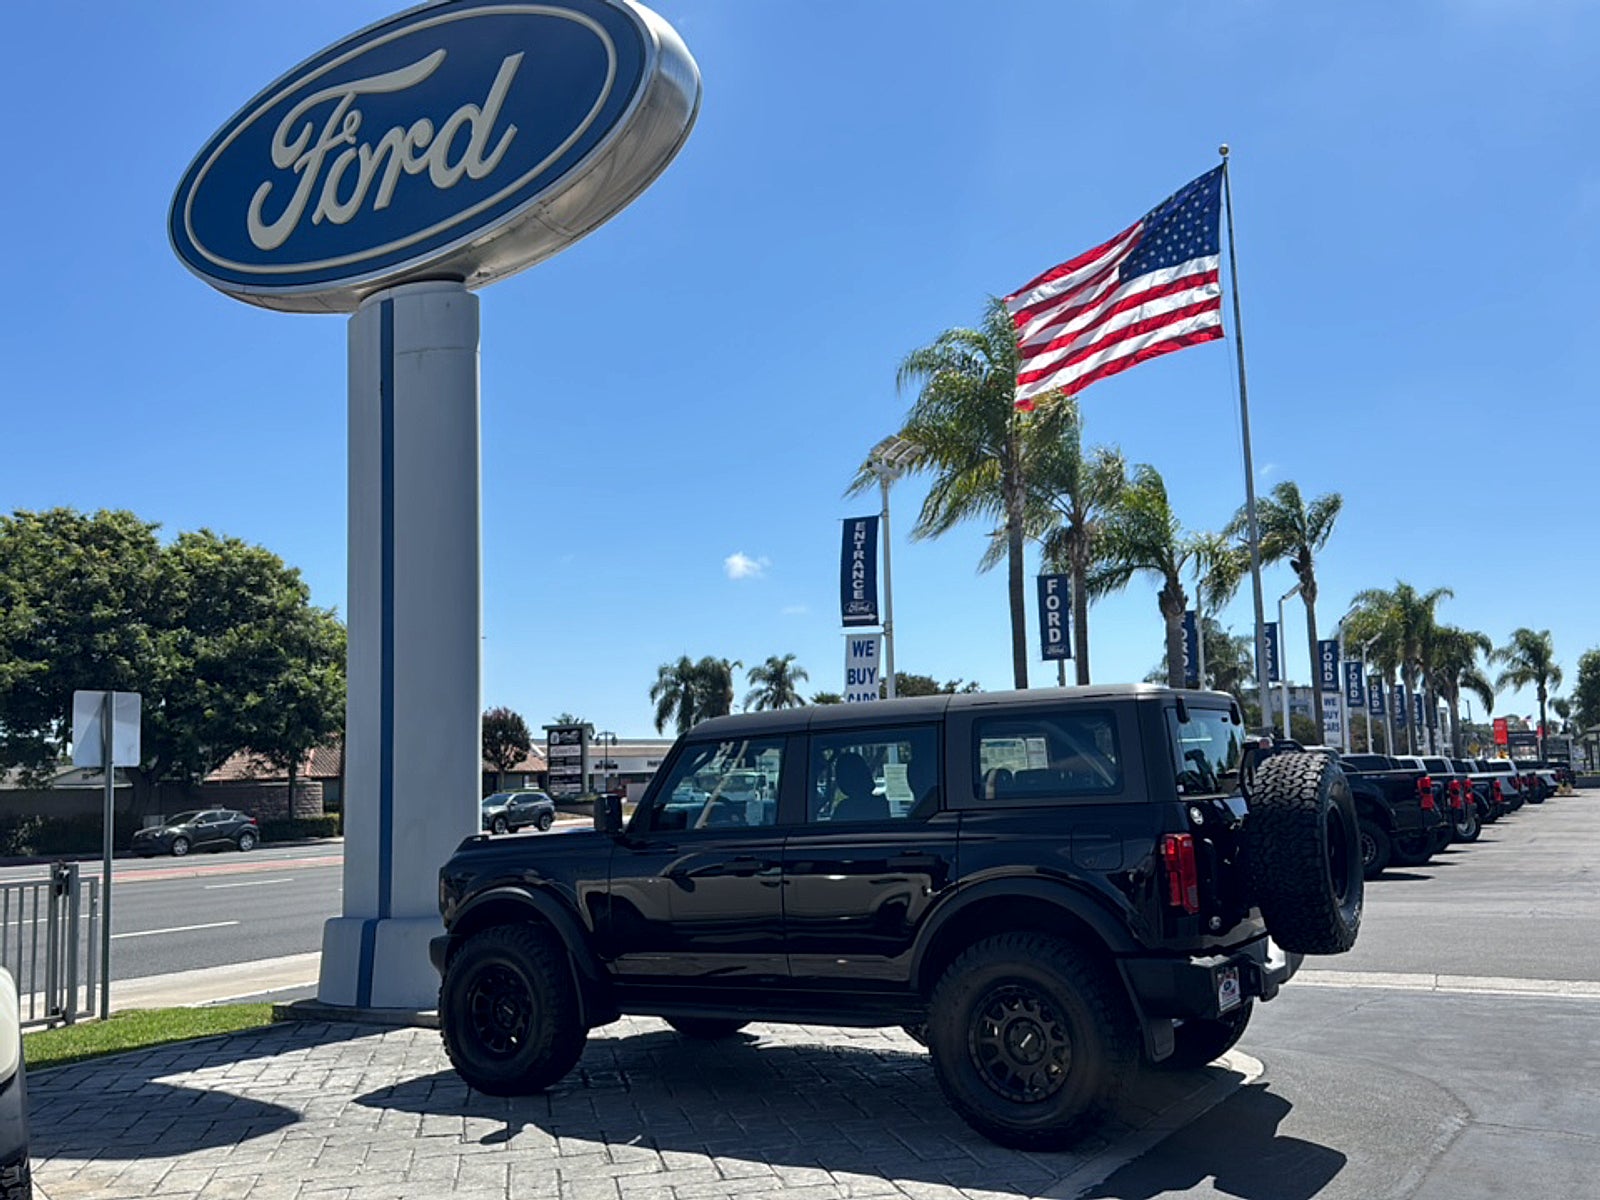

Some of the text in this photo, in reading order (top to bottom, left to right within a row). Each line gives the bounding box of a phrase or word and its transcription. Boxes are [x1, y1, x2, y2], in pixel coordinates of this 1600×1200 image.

[247, 47, 525, 251] Ford
[852, 521, 866, 600] ENTRANCE
[1046, 578, 1062, 644] FORD
[852, 639, 875, 658] WE
[1323, 641, 1334, 681] FORD
[847, 667, 877, 685] BUY
[1349, 663, 1359, 699] FORD
